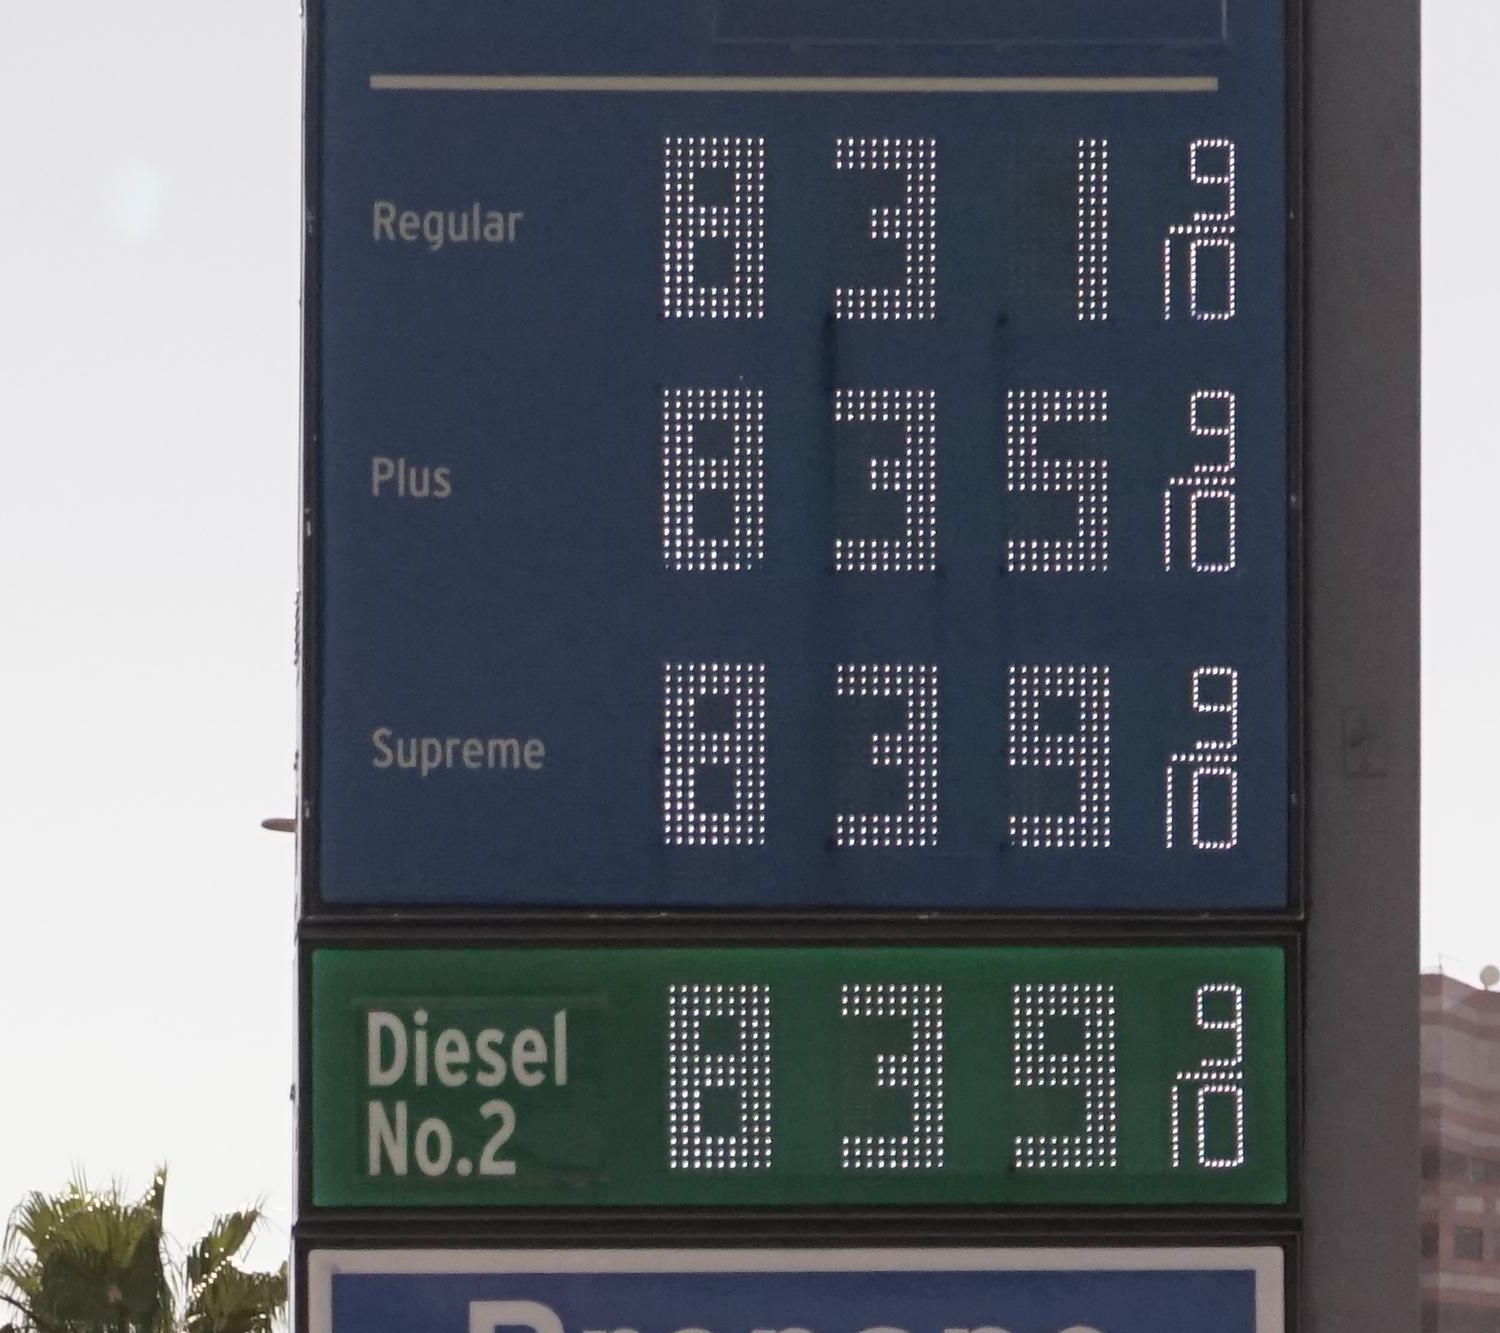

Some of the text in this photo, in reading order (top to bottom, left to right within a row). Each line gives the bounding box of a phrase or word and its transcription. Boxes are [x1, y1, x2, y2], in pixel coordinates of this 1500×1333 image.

[372, 203, 524, 251] Regular
[371, 456, 453, 498] Plus
[372, 729, 547, 778] Supreme
[366, 1008, 570, 1087] Diesel
[366, 1101, 519, 1177] No.2
